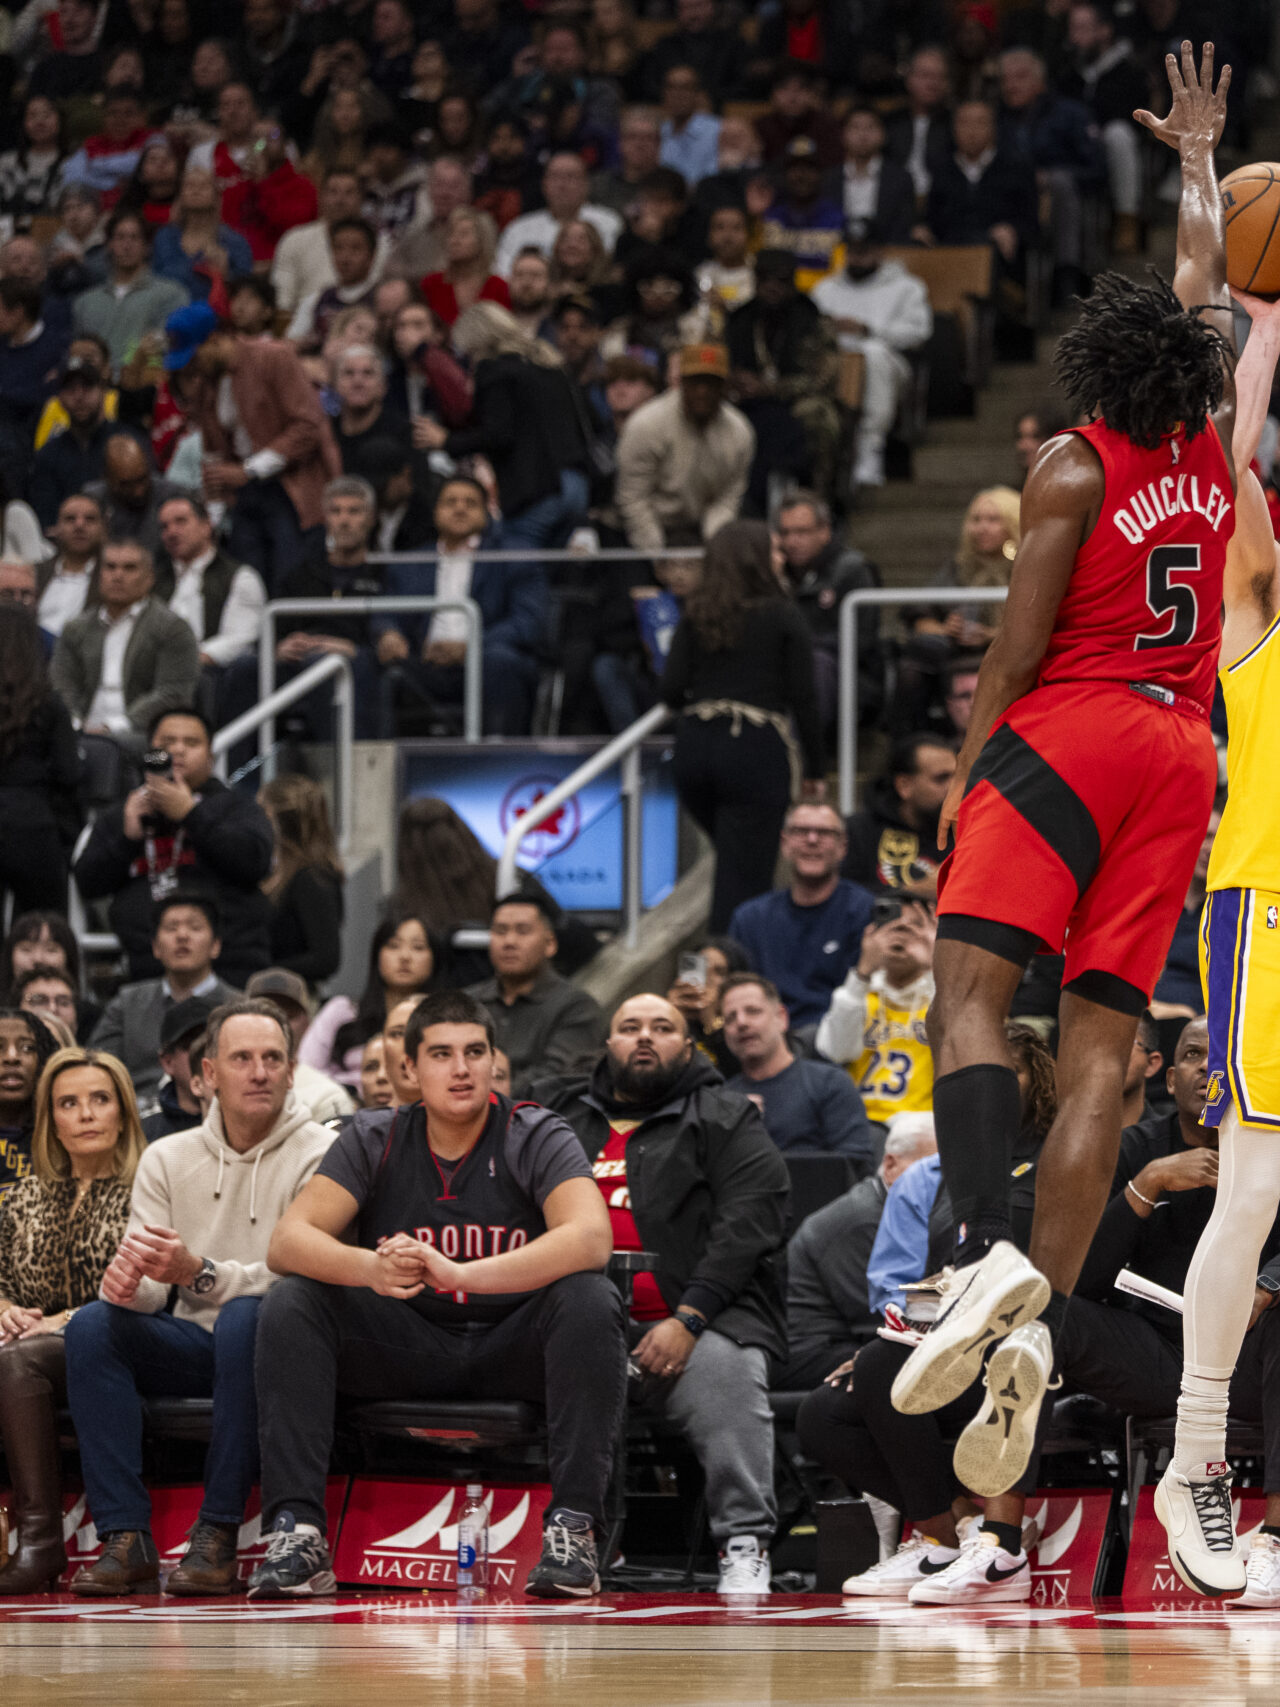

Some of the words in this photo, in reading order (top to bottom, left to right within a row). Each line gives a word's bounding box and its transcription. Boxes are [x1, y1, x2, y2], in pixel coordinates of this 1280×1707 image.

[1113, 473, 1231, 545] QUICKLEY
[1133, 543, 1201, 652] 5
[859, 1049, 914, 1098] 23
[377, 1224, 528, 1259] RONTO
[358, 1557, 515, 1585] MAGELN
